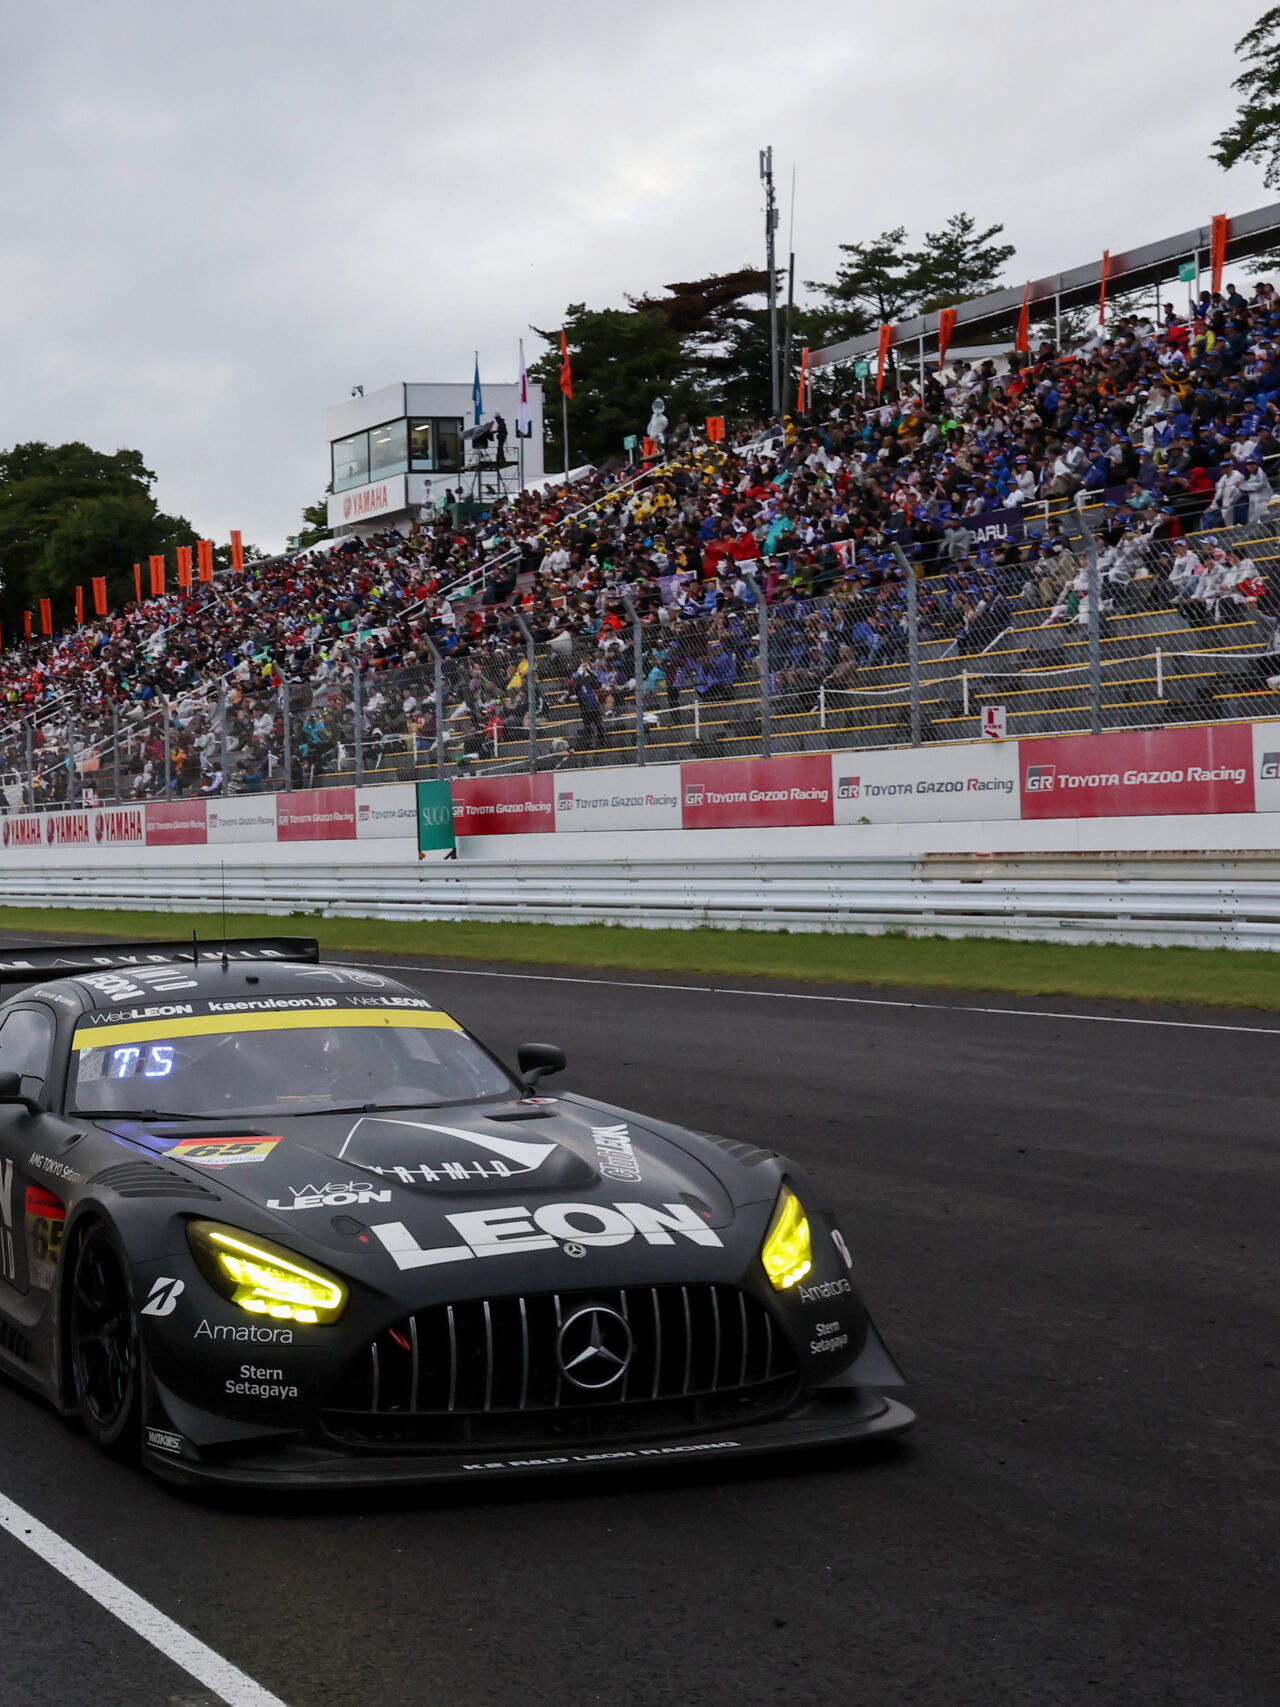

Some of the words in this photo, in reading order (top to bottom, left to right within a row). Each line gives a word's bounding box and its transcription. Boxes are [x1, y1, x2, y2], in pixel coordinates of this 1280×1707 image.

[352, 485, 388, 515] YAMAHA
[969, 523, 1008, 544] BARU
[838, 785, 859, 798] GR
[864, 784, 912, 796] TOYOTA
[916, 781, 963, 793] GAZOO
[967, 778, 1013, 794] Racing
[1026, 775, 1053, 790] GR
[1058, 774, 1119, 788] TOYOTA
[1123, 770, 1183, 785] GAZOO
[1187, 766, 1246, 784] Racing
[575, 799, 609, 808] TOYOTA
[611, 797, 643, 806] GAZOO
[645, 794, 677, 807] Racing
[706, 792, 747, 803] TOYOTA
[749, 790, 788, 801] GAZOO
[790, 788, 828, 802] Racing
[371, 811, 396, 819] TOYOTA
[397, 809, 417, 818] GAZO
[466, 806, 495, 815] TOYOTA
[496, 804, 524, 813] GAZOO
[525, 802, 552, 813] Racing
[11, 818, 41, 845] YAMAHA
[56, 814, 89, 843] YAMAHA
[105, 811, 142, 841] YAMAHA
[74, 974, 146, 1001] LEON
[90, 1004, 193, 1024] WebLEON
[208, 997, 338, 1012] kaeruleon.jp
[345, 996, 432, 1008] WebLEON
[184, 1143, 262, 1157] 65
[28, 1152, 44, 1168] AMG
[43, 1157, 63, 1176] TOKYO
[367, 1160, 512, 1184] YRAMID
[267, 1190, 392, 1210] LEON
[288, 1181, 373, 1197] Web
[31, 1216, 65, 1264] 65
[370, 1202, 724, 1271] LEON
[798, 1278, 851, 1304] Amatora
[194, 1319, 293, 1344] Amatora
[816, 1320, 840, 1337] Stern
[810, 1332, 848, 1354] Setagaya
[240, 1364, 283, 1380] Stern
[225, 1380, 298, 1399] Setagaya
[509, 1456, 569, 1467] R&D
[572, 1450, 637, 1461] LEON
[639, 1441, 742, 1455] RACING
